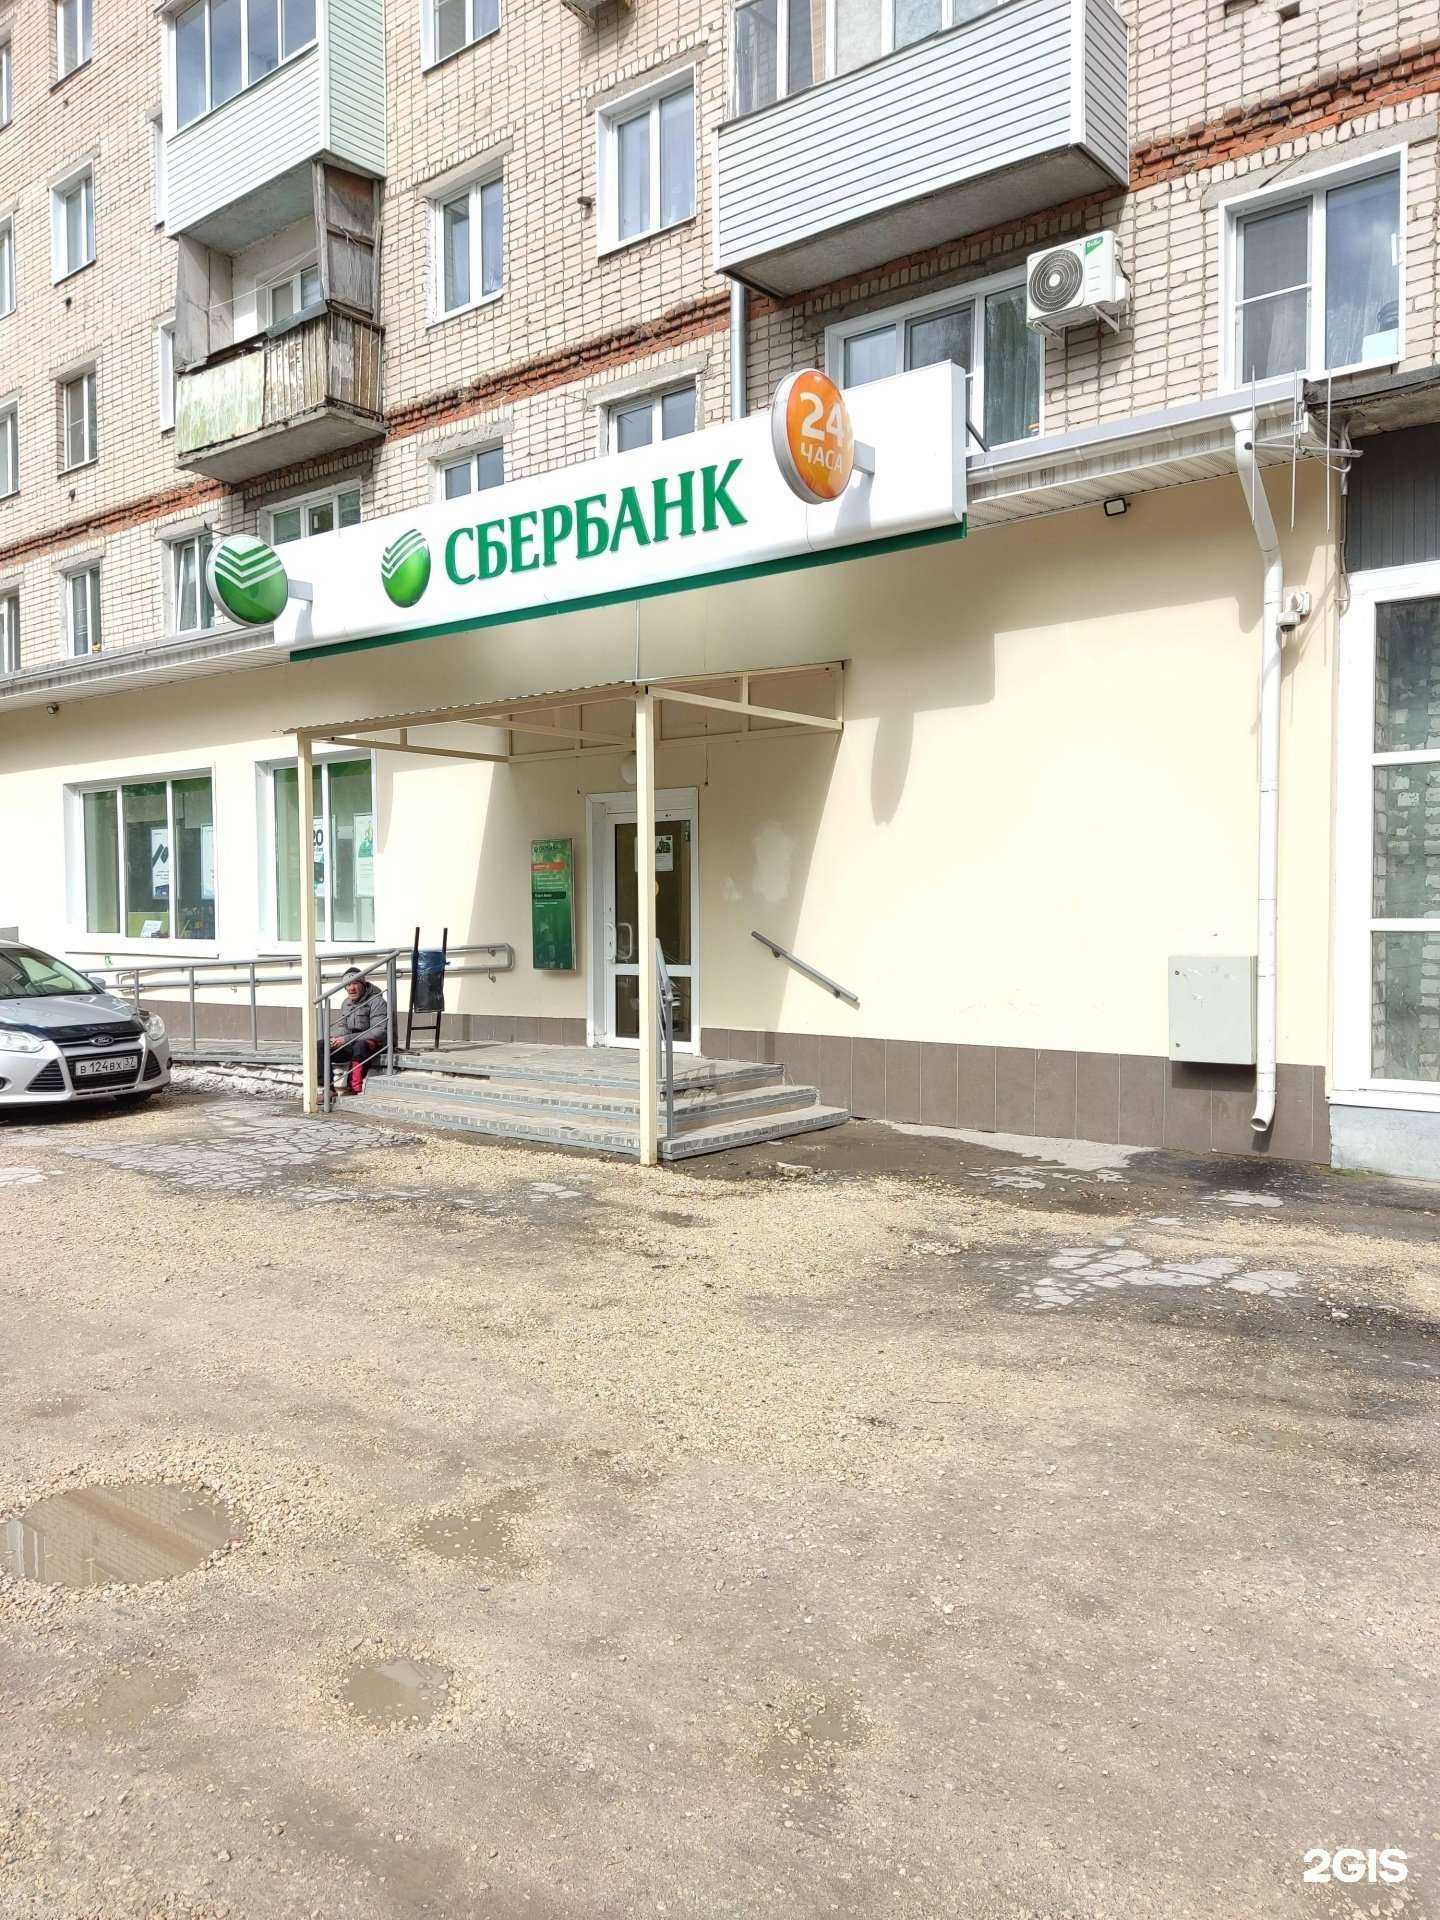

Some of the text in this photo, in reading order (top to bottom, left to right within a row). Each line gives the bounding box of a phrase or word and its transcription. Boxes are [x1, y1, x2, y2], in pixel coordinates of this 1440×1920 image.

[800, 391, 845, 448] 24
[800, 441, 843, 472] ЧАСА
[444, 458, 748, 585] СБЕРБАНК
